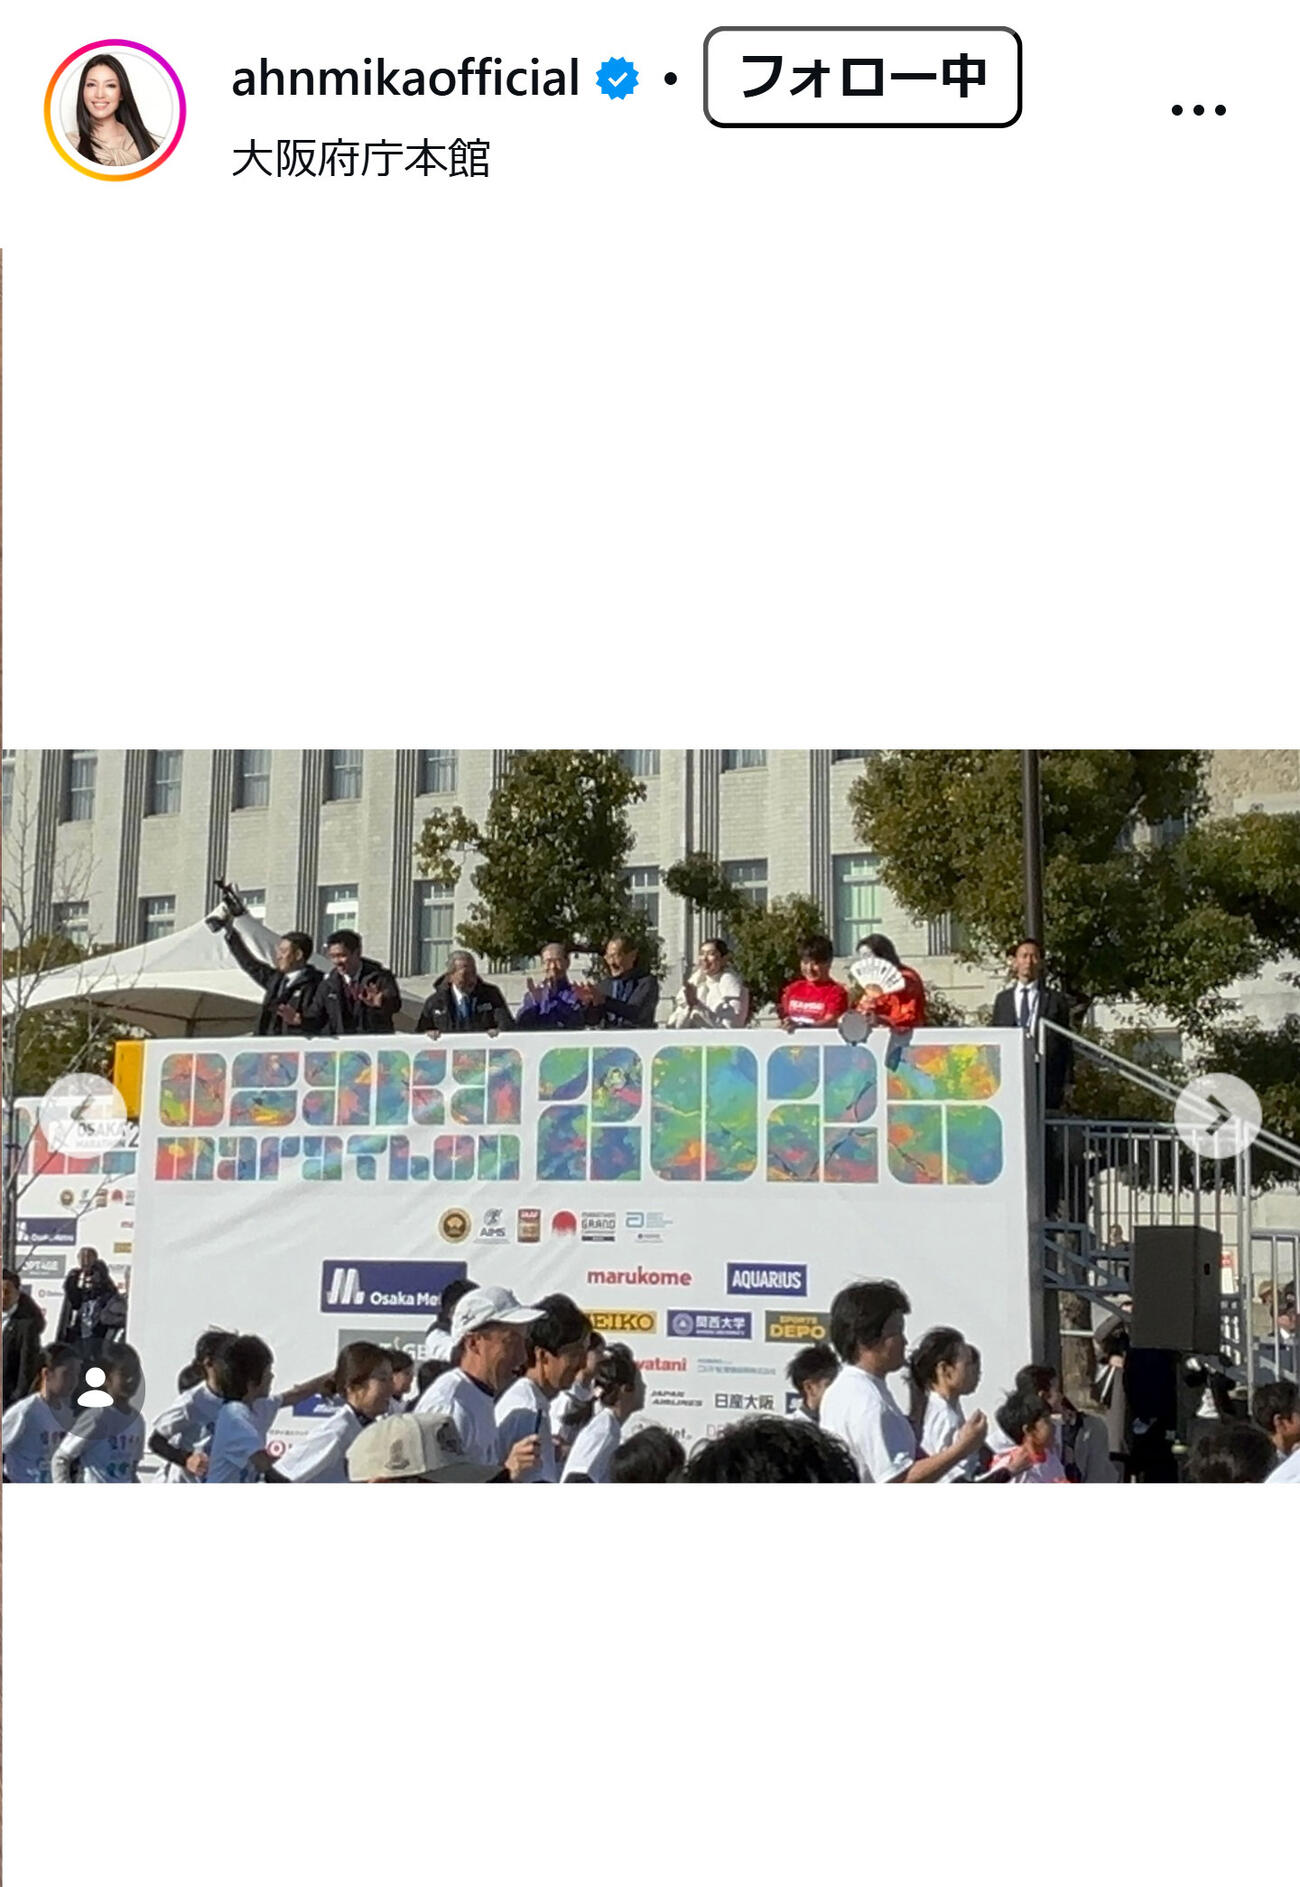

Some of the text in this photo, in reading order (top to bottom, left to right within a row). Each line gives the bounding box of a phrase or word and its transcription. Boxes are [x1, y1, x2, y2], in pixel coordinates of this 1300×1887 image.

[480, 1227, 506, 1237] AIMS
[587, 1266, 692, 1286] marukome
[732, 1269, 802, 1290] AQUARIUS
[370, 1291, 415, 1305] Osaka
[588, 1313, 655, 1331] EIKO
[769, 1323, 826, 1340] DEPO
[715, 1393, 775, 1410] 日産大阪
